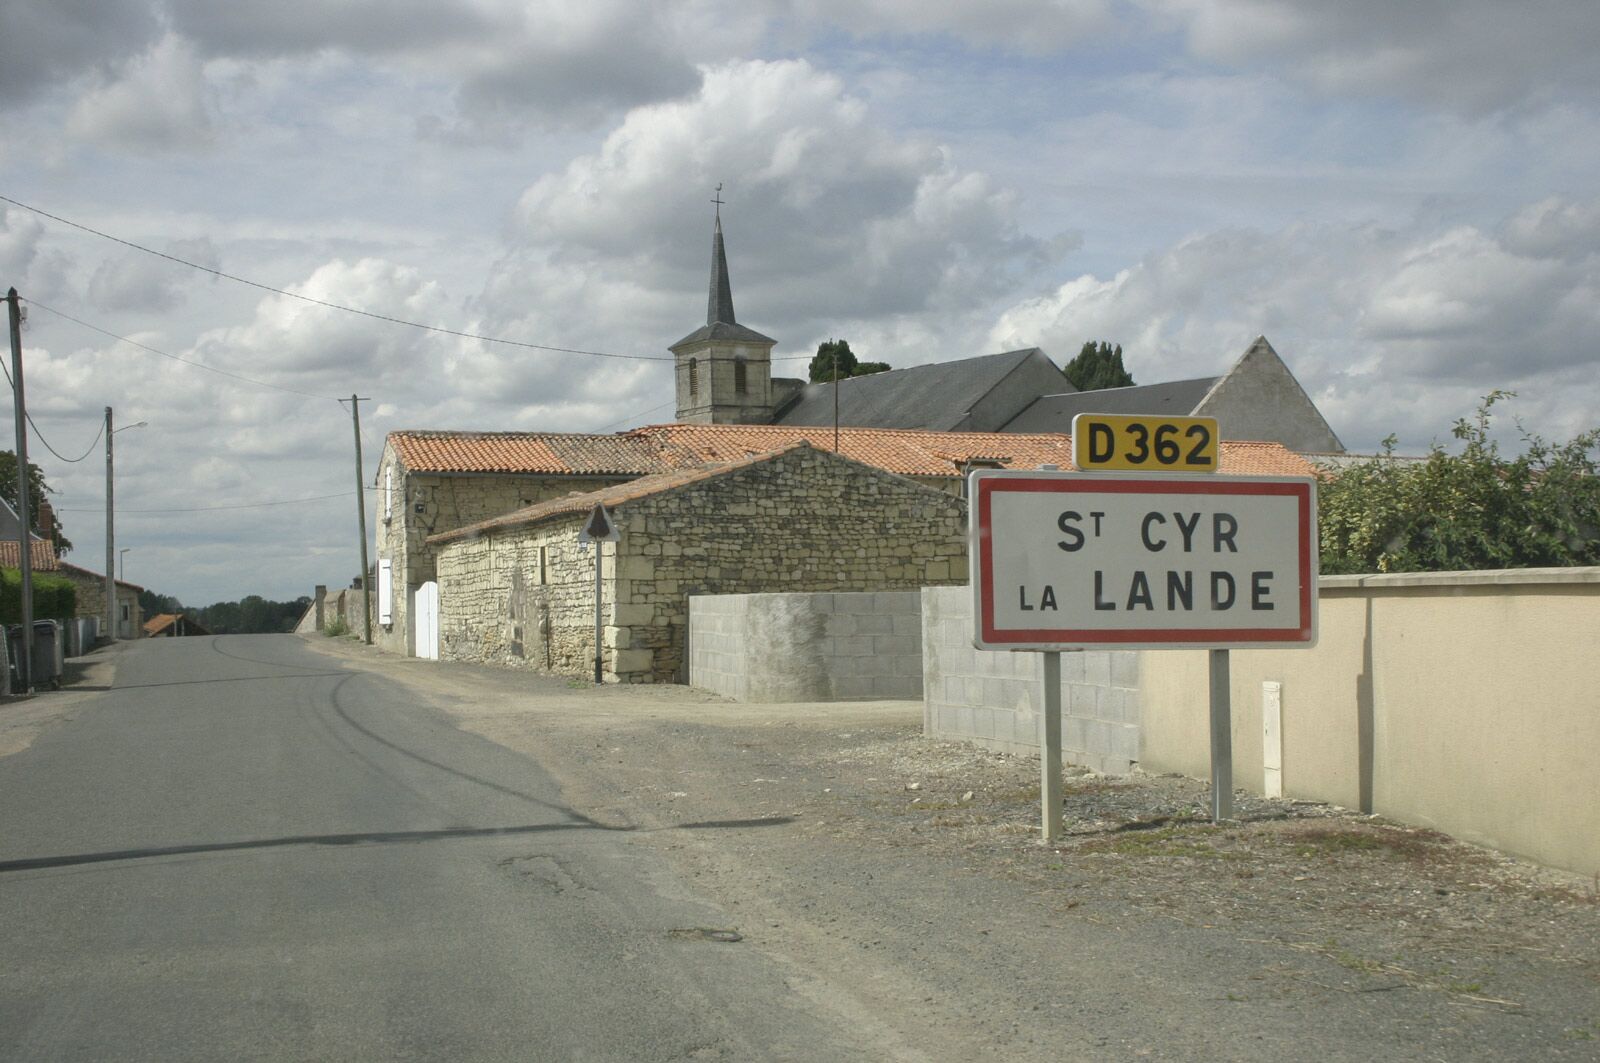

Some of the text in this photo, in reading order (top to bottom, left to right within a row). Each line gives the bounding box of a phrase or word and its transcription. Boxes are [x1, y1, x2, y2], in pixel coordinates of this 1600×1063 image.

[1140, 511, 1239, 553] CYR
[1019, 570, 1275, 612] LA LANDE
